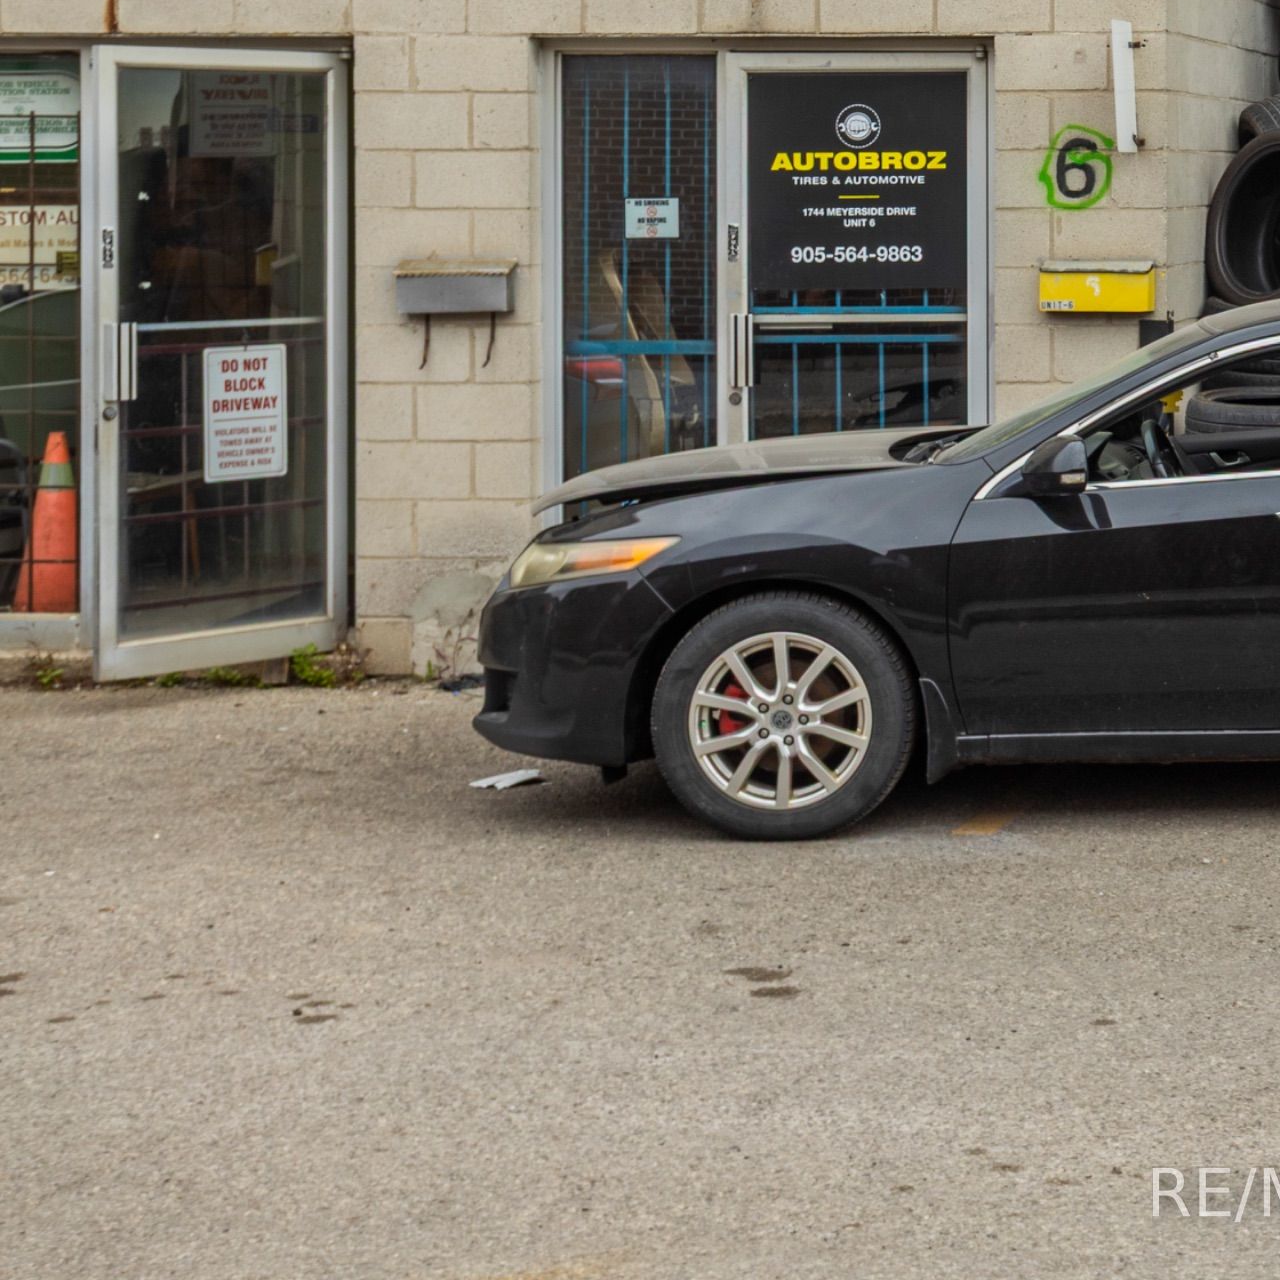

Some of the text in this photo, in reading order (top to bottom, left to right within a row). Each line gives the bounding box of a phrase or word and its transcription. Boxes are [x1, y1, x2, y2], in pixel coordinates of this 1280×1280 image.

[770, 151, 947, 171] AUTOBROZ
[1056, 138, 1097, 198] 6
[792, 176, 925, 185] TIRES & AUTOMOTIVE
[802, 207, 917, 216] 1744 MEYERSIDE DRIVE
[843, 219, 876, 227] UNIT 6
[790, 246, 923, 263] 905-564-9863
[1041, 301, 1074, 309] UNIT-6
[221, 357, 268, 373] DO NOT
[224, 377, 266, 393] BLOCK
[212, 395, 278, 414] DRIVEWAY
